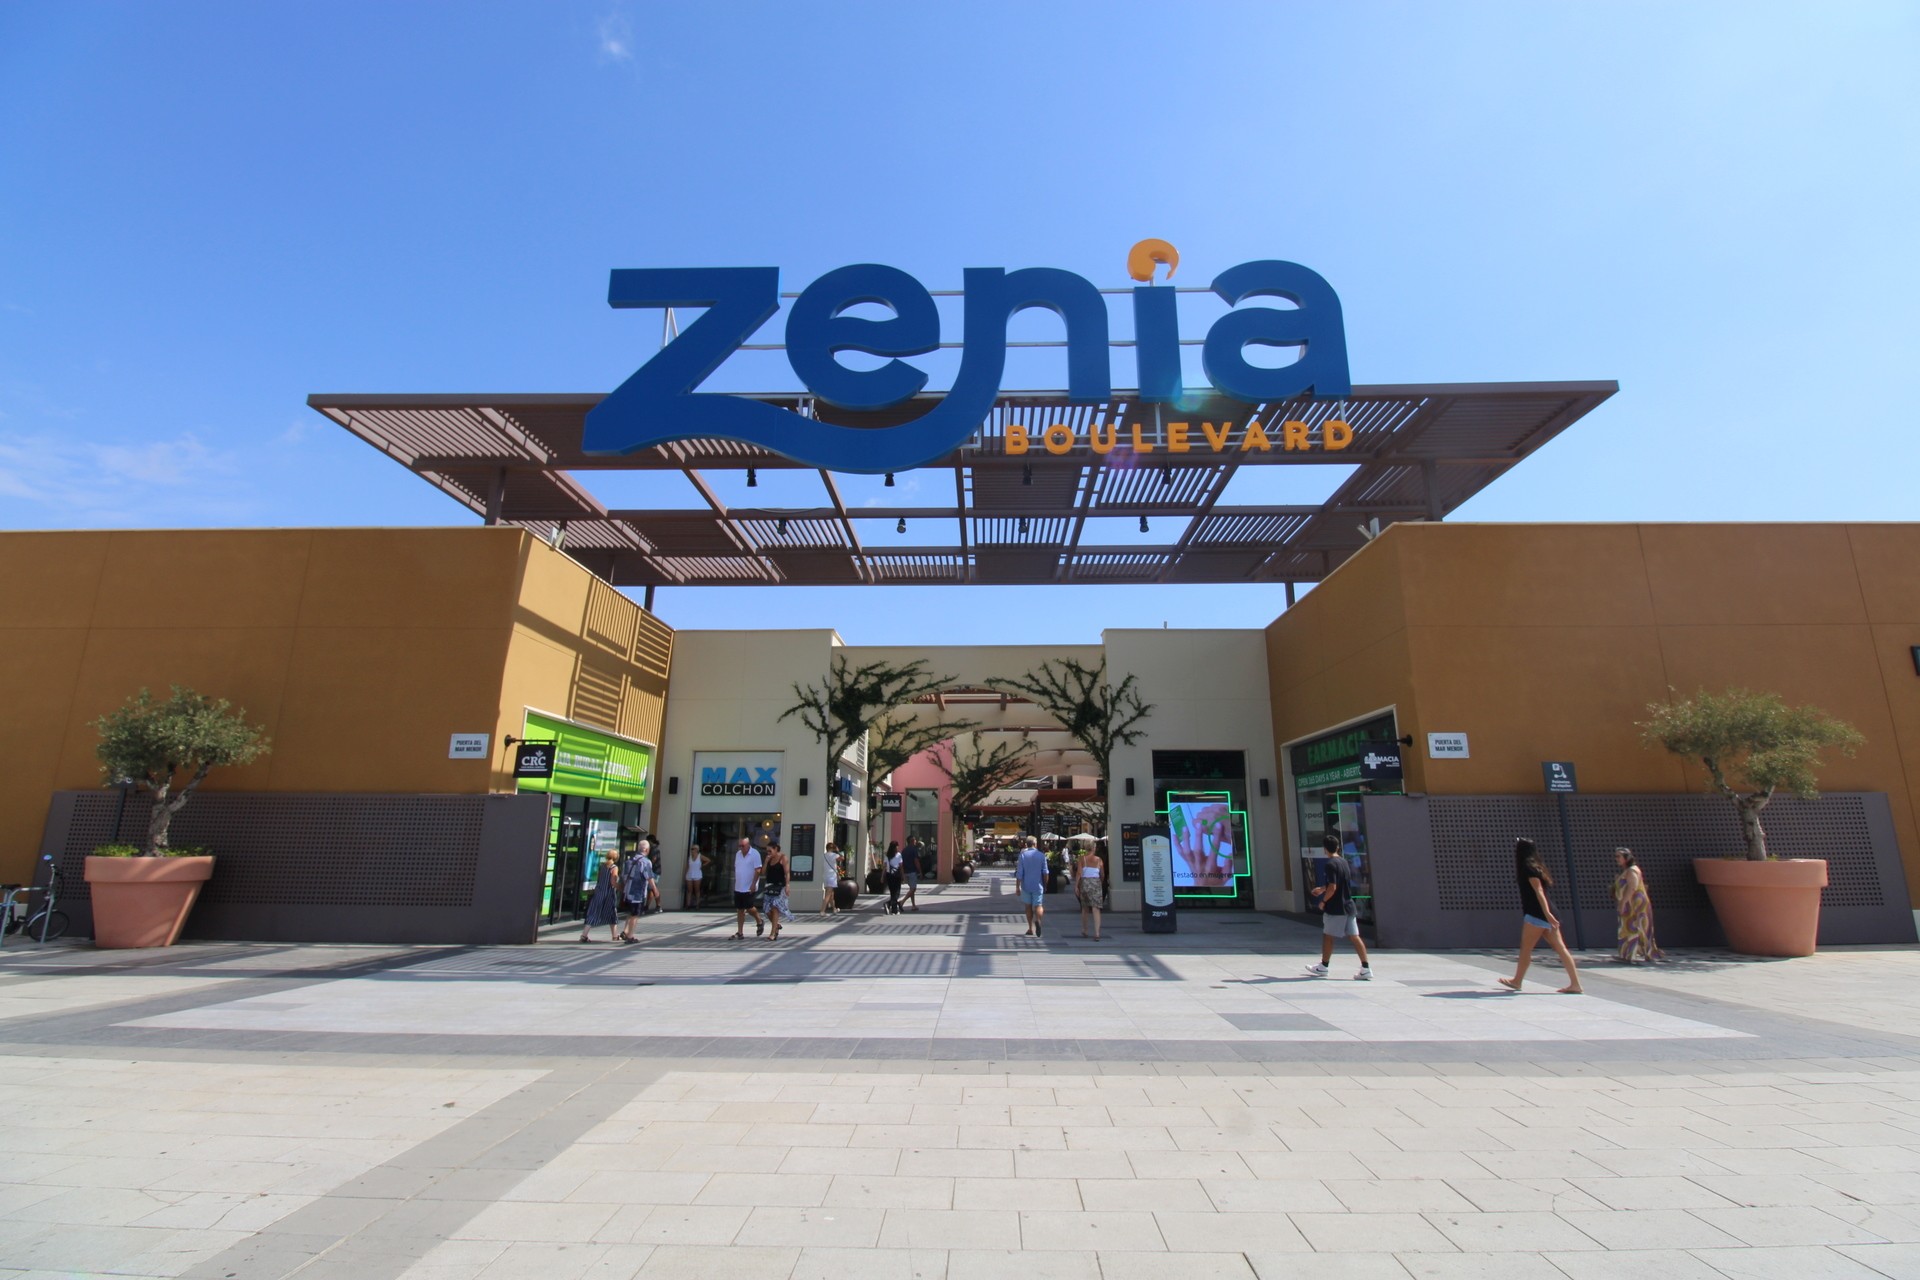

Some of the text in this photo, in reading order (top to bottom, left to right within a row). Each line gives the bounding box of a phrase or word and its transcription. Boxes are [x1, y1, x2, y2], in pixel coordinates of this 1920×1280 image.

[583, 238, 1352, 473] zenia
[1005, 420, 1354, 456] BOULEVARD
[521, 756, 547, 766] CRC
[1307, 730, 1369, 766] FARMACIA
[701, 767, 777, 784] MAX
[703, 784, 775, 795] COLCHON
